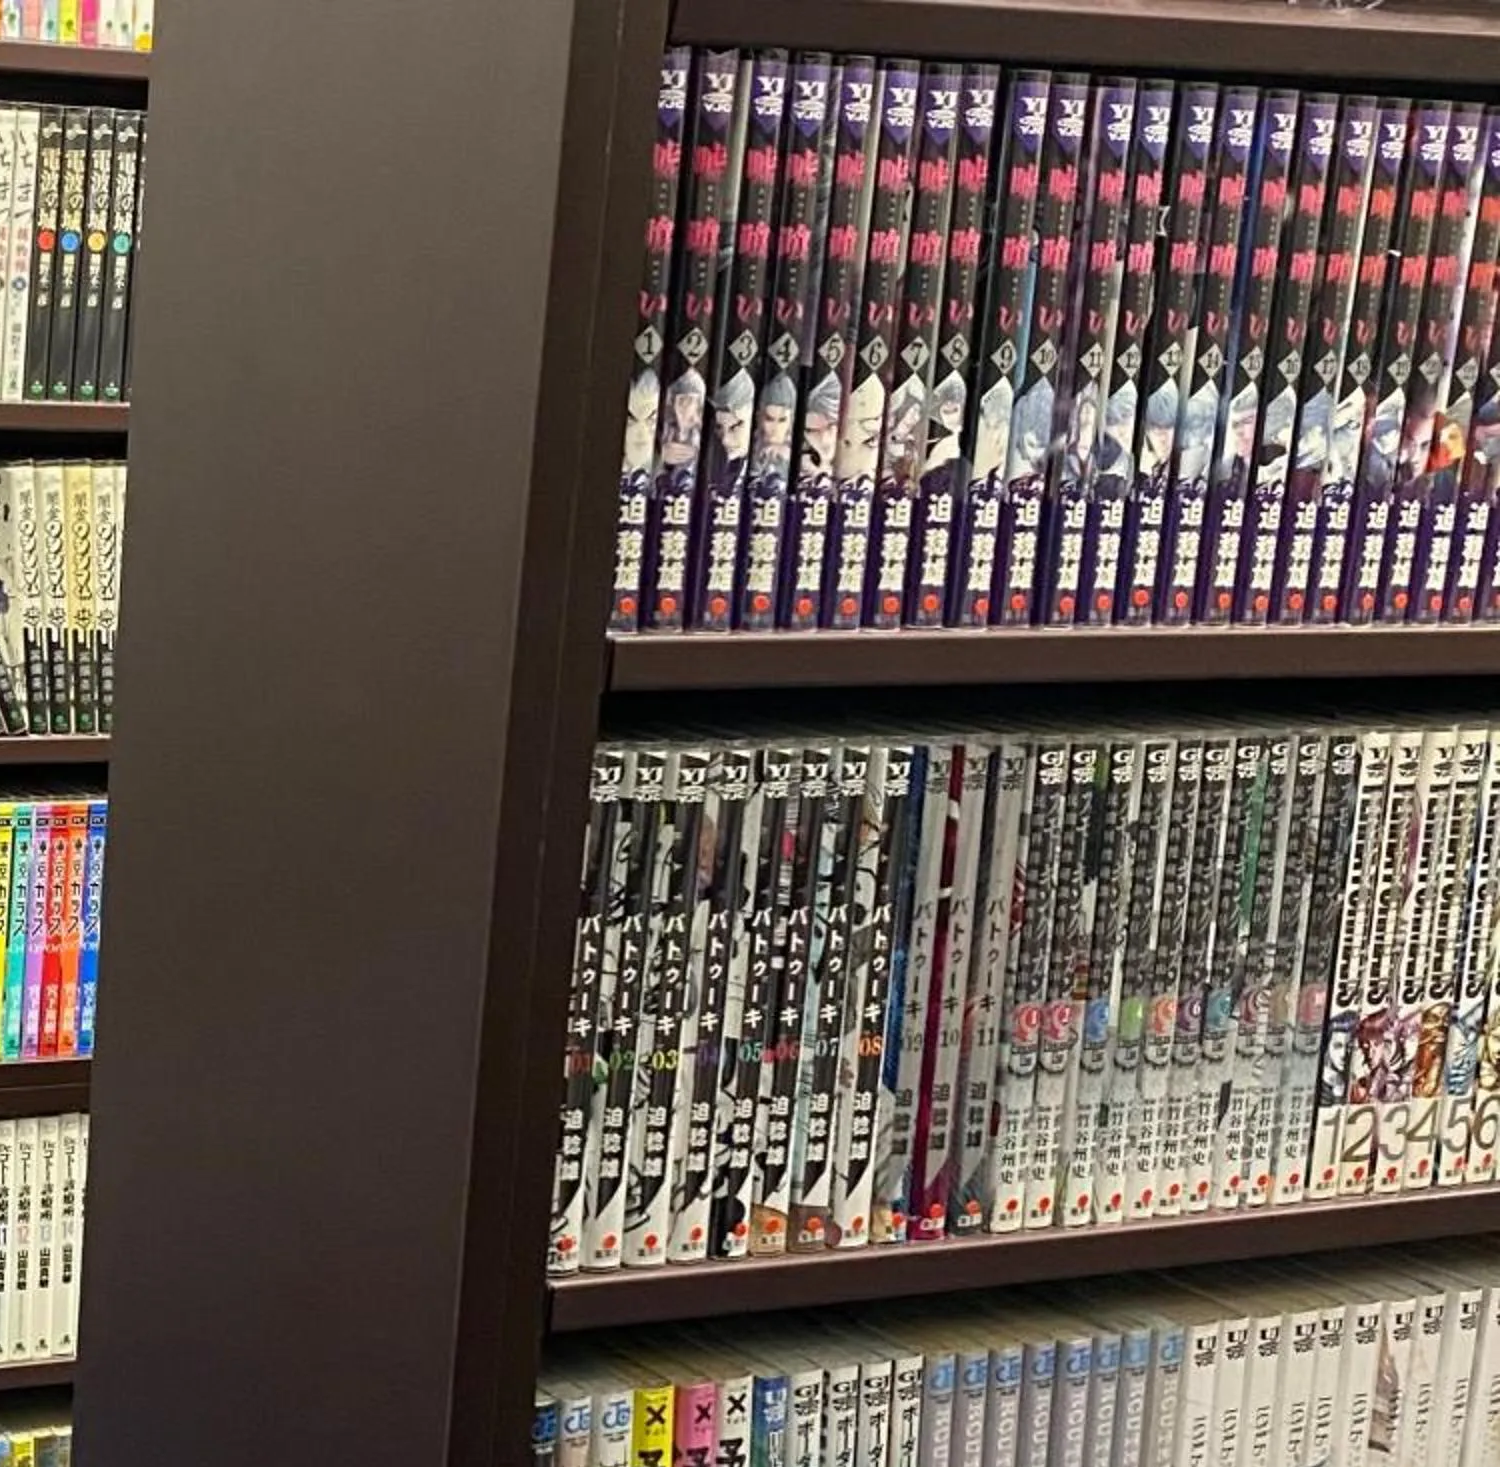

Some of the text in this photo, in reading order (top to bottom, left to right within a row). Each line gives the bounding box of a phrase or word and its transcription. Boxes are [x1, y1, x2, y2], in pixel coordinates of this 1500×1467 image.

[644, 334, 655, 353] 1
[687, 334, 700, 356] 2
[737, 337, 752, 360] 3
[777, 339, 792, 361] 4
[827, 339, 840, 361] 5
[869, 341, 883, 364] 6
[911, 343, 924, 365] 7
[951, 338, 965, 361] 8
[999, 343, 1012, 369] 9
[814, 1034, 839, 1057] 07
[860, 1034, 882, 1058] 08
[940, 1027, 960, 1050] 10
[978, 1026, 997, 1049] 11
[653, 1049, 678, 1071] 03
[740, 1041, 762, 1063] 05
[1321, 1106, 1341, 1165] 1
[1347, 1107, 1373, 1163] 2
[1379, 1105, 1406, 1160] 3
[1406, 1103, 1438, 1155] 4
[1445, 1102, 1471, 1153] 5
[1475, 1102, 1497, 1149] 6
[17, 1224, 29, 1243] 12
